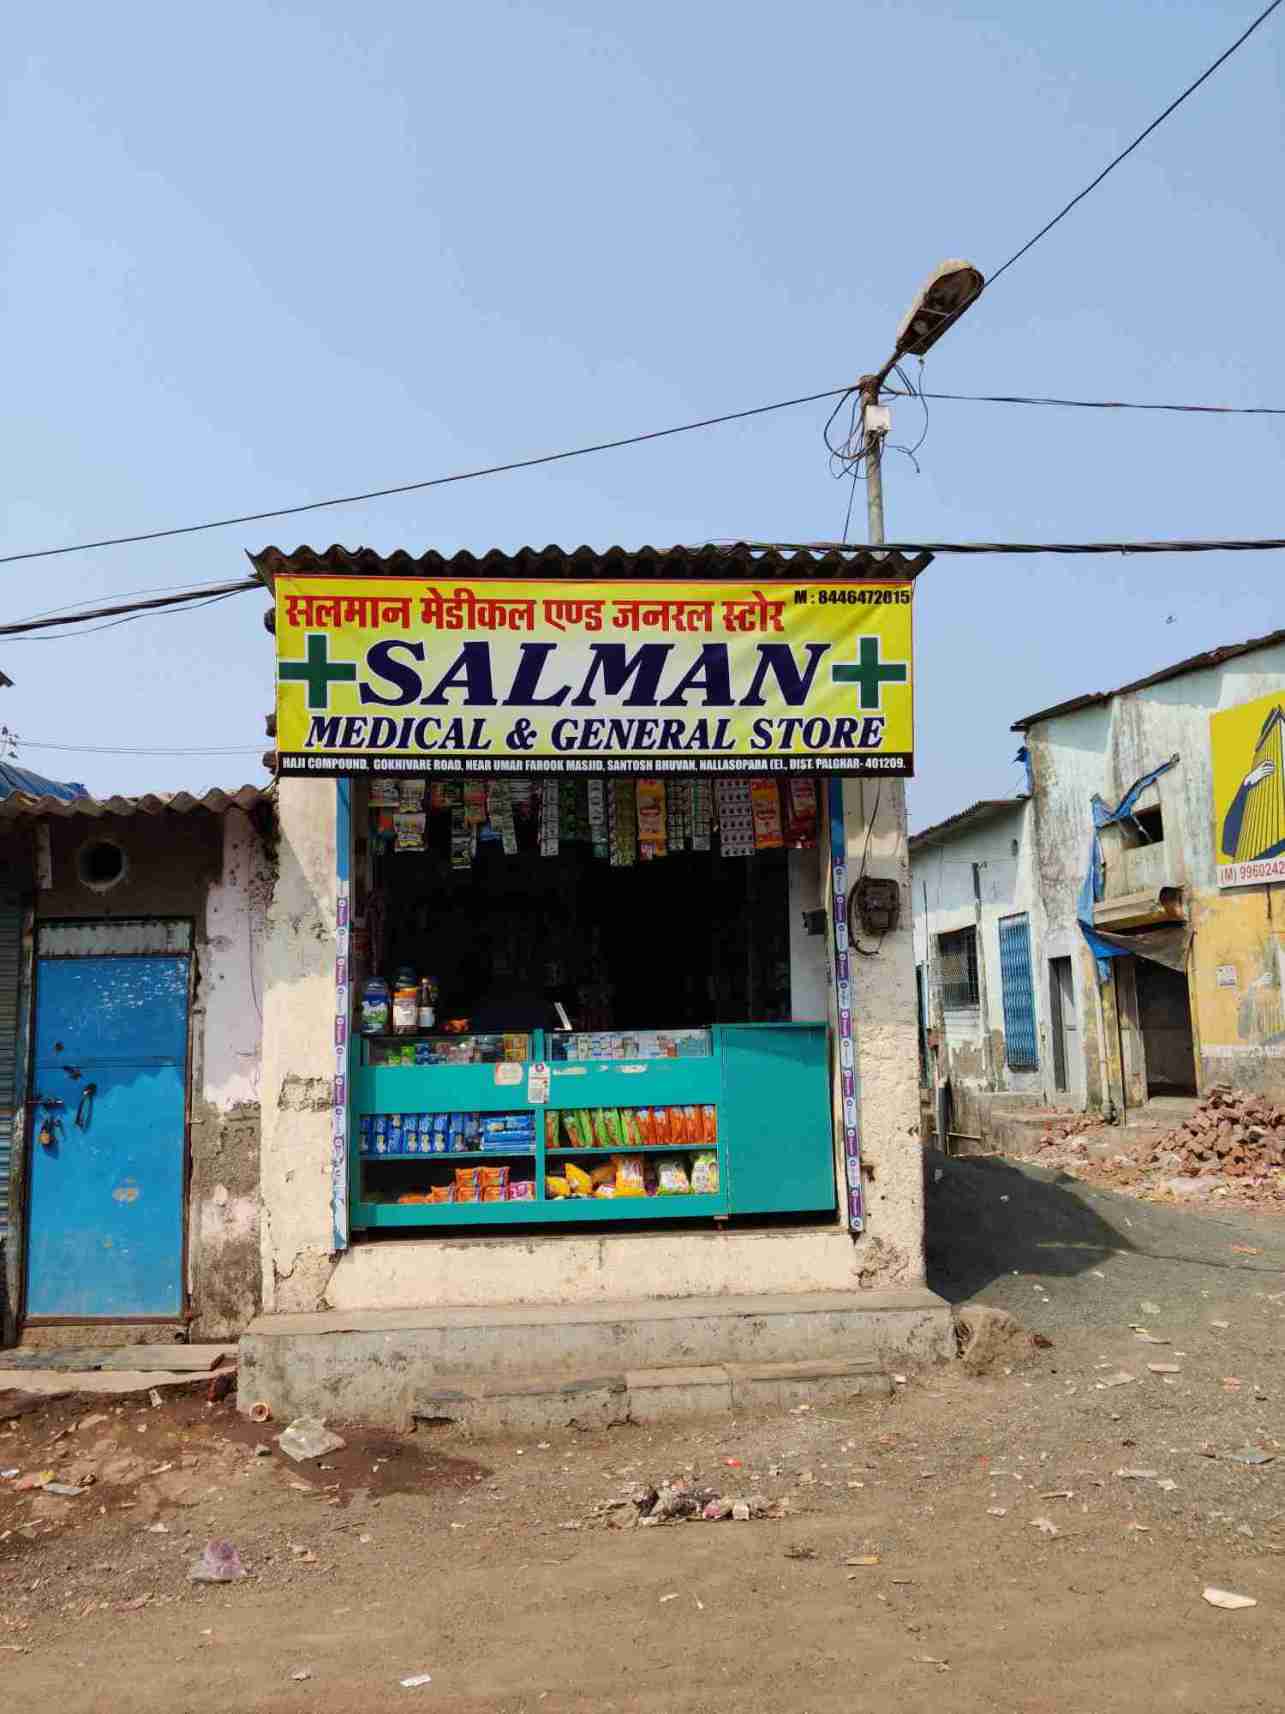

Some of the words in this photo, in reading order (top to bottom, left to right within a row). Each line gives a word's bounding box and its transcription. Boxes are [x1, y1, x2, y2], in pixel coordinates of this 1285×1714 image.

[284, 595, 413, 629] सलमान
[421, 587, 536, 632] मेडीकल
[543, 599, 605, 632] एण्ड
[612, 600, 715, 632] जनरल
[722, 591, 787, 632] स्टोर
[794, 590, 807, 604] M
[818, 590, 910, 604] 8446472015
[358, 639, 831, 708] SALMAN
[305, 716, 492, 751] MEDICAL
[505, 717, 538, 751] &
[551, 717, 736, 751] GENERAL
[750, 716, 886, 750] STORE
[282, 757, 306, 769] HAJI
[307, 757, 369, 771] COMPOUND,
[433, 759, 464, 771] ROAD,
[465, 759, 492, 771] NEAR
[525, 759, 564, 771] FAROOK
[566, 759, 605, 772] MASJID,
[607, 759, 653, 771] SANTOSH
[655, 759, 698, 772] BHUVAN,
